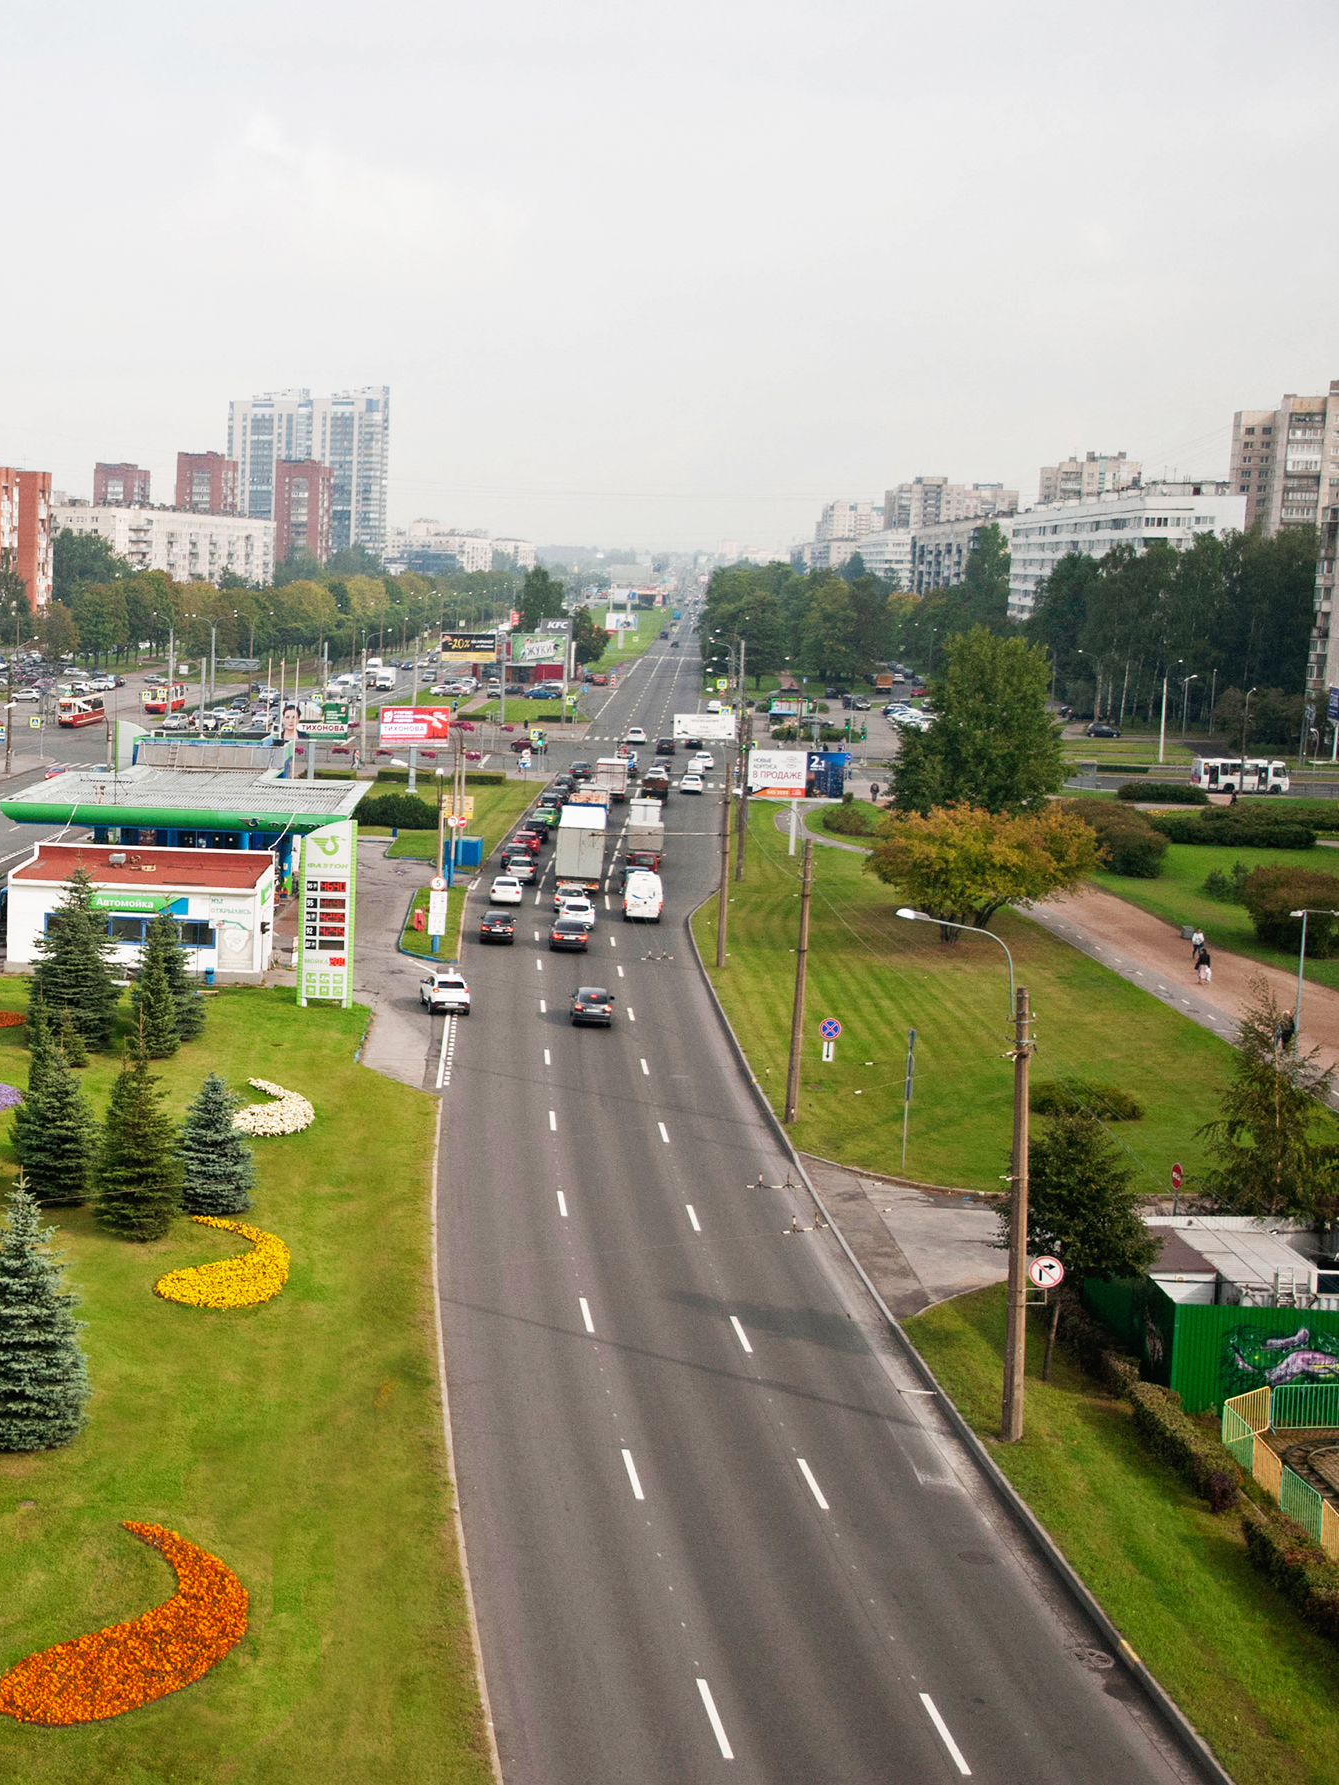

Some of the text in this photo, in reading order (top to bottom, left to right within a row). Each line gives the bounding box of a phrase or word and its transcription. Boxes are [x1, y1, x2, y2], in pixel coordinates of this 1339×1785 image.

[546, 621, 569, 629] KFC
[448, 638, 471, 650] -20%
[526, 643, 554, 656] ЖУКИ
[301, 724, 345, 732] ТИХОНОВА
[760, 771, 802, 780] ПРОДАЖЕ
[436, 879, 441, 887] 5
[96, 897, 154, 909] Автомойка
